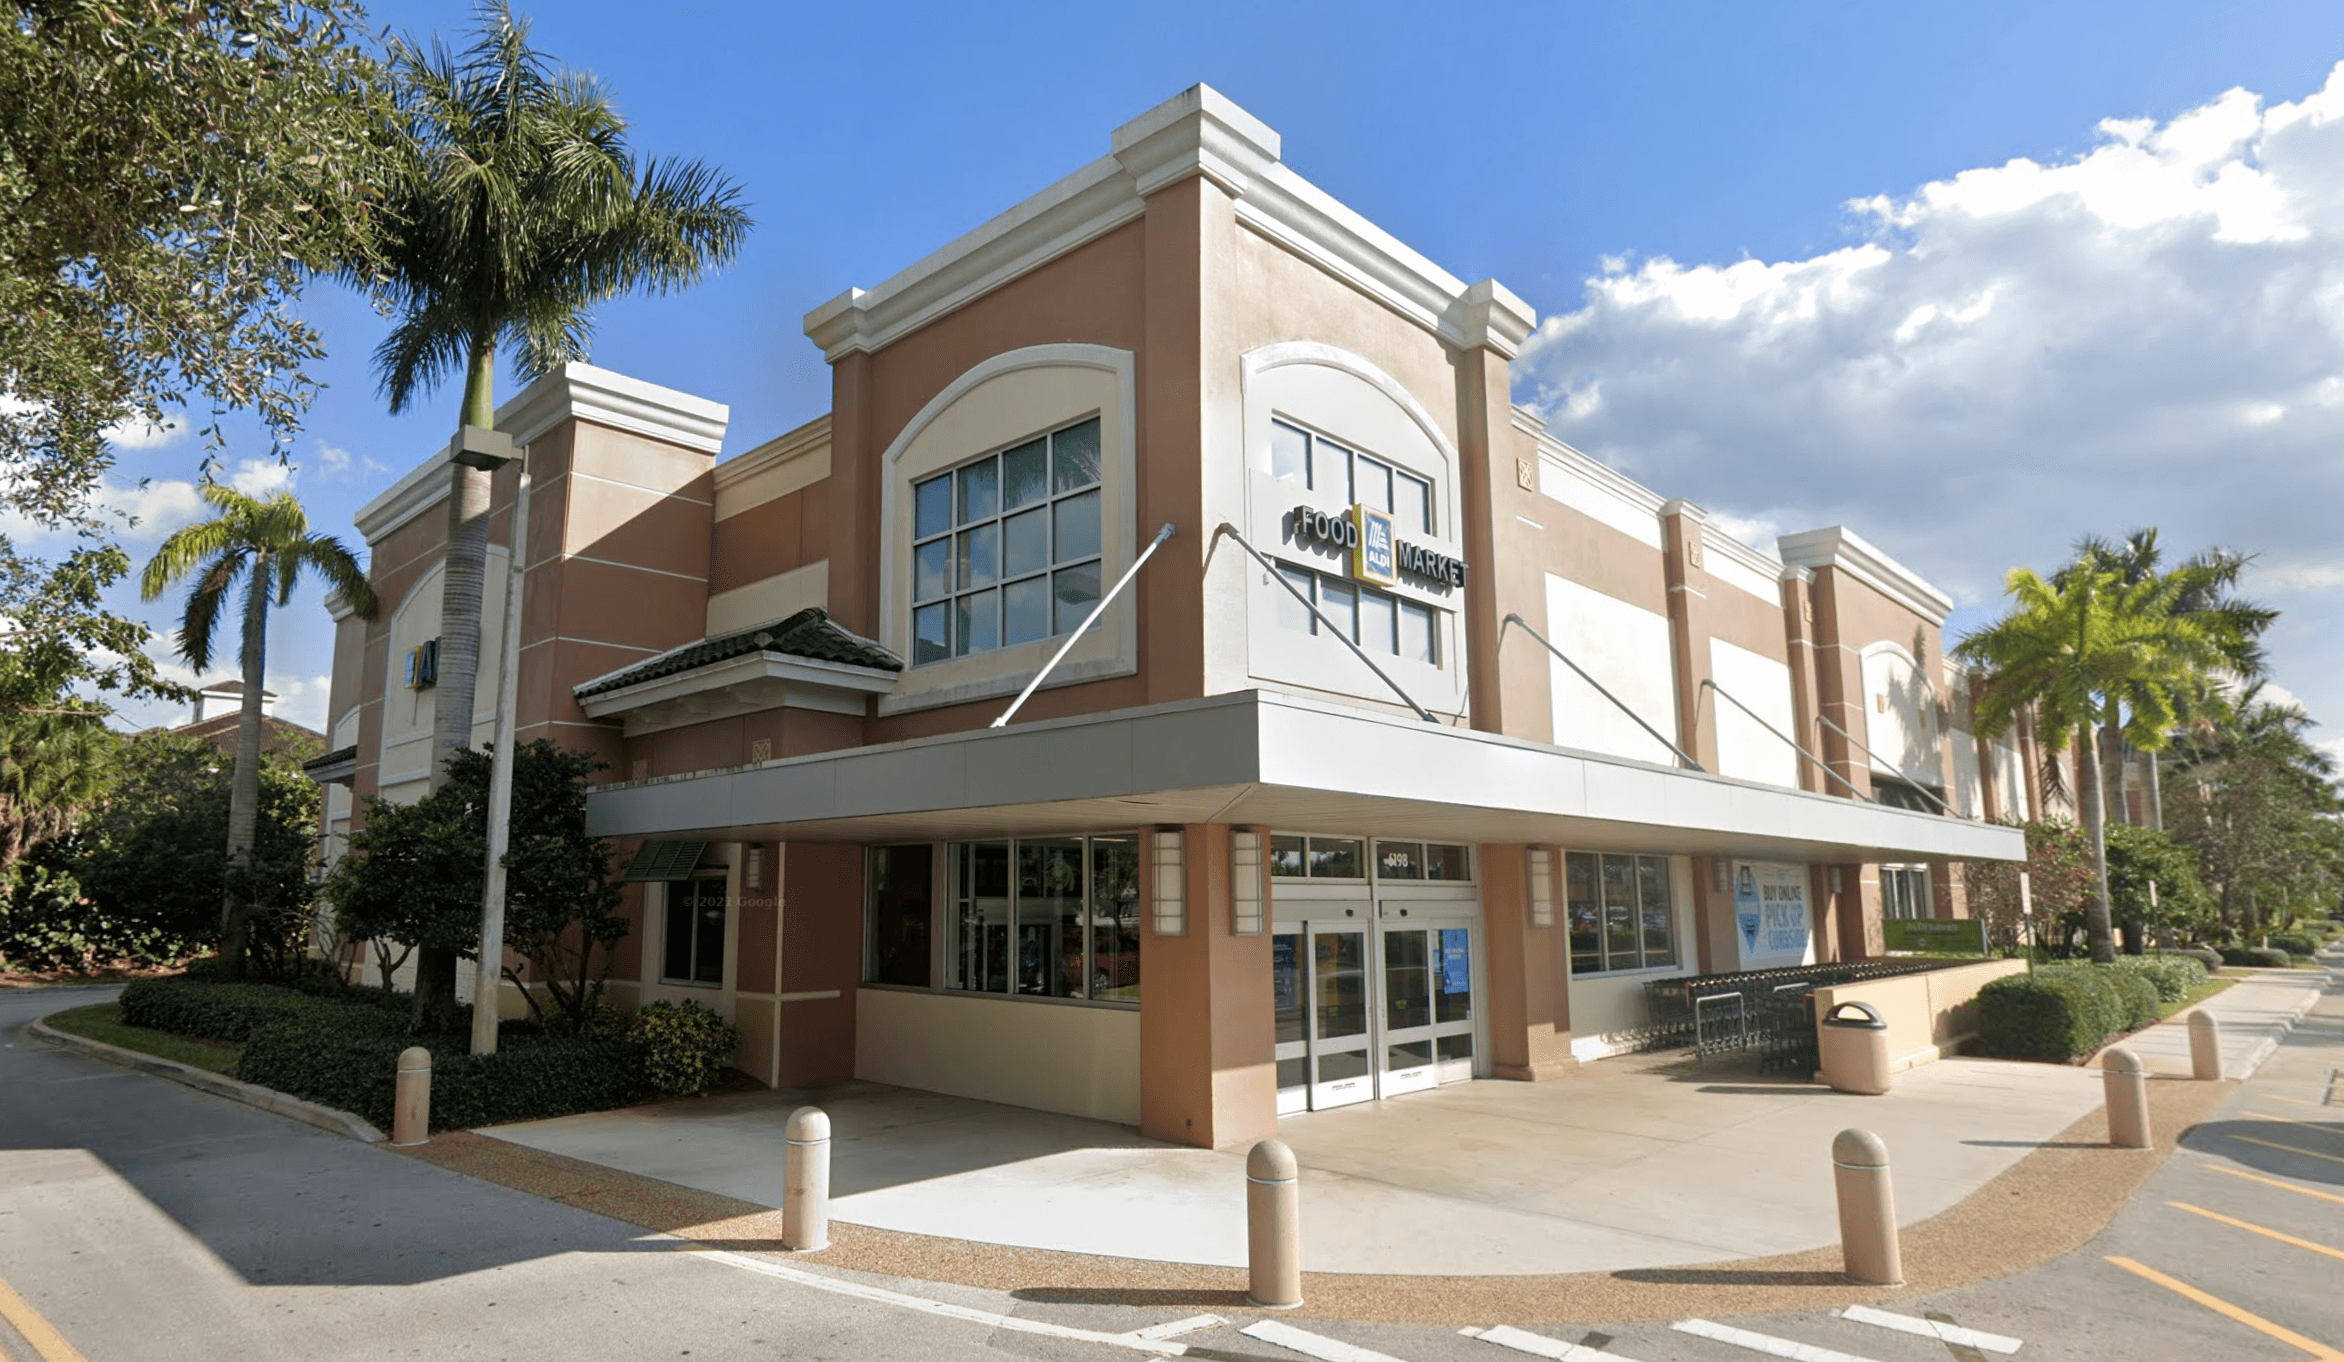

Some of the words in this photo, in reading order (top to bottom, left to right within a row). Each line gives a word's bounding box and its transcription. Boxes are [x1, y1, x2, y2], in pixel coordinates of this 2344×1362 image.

[1299, 505, 1359, 549] FOOD
[1397, 539, 1469, 588] MARKET
[1368, 551, 1390, 568] ALDI
[1763, 885, 1777, 900] BUY
[1778, 885, 1802, 901] ONLINE
[1765, 903, 1789, 928] PICK
